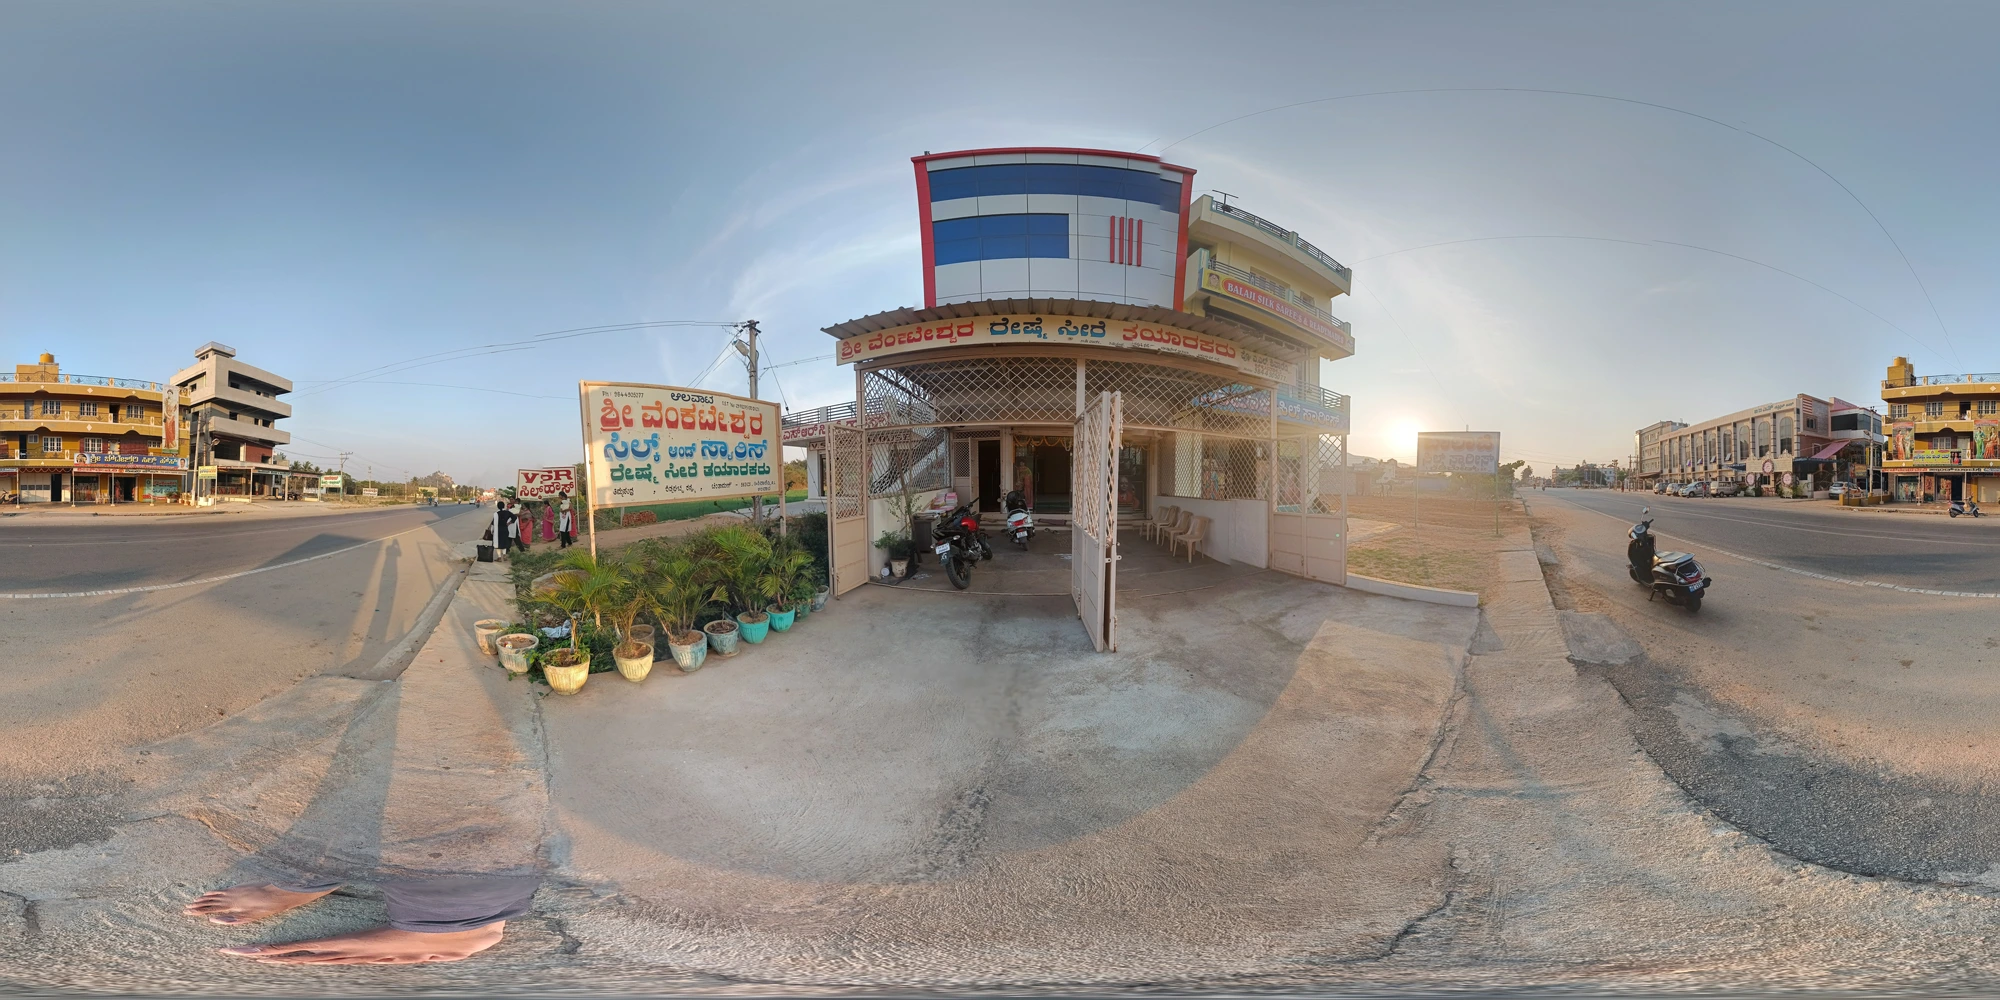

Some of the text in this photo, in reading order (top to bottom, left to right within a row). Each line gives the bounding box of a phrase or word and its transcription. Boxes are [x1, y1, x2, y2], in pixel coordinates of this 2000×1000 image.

[1226, 283, 1256, 301] BALAJI
[1257, 294, 1275, 310] SILK
[1302, 317, 1309, 327] &
[841, 316, 1236, 360] ಶ್ರೀ ವೆಂಕಟೇಶ್ವರ ರೇಷ್ಮೆ ಸೀರೆ ತಯಾರಕರು
[600, 398, 763, 439] ಶ್ರೀ ವೆಂಕಟೇಶ್ವರ
[604, 432, 661, 464] ಸಿಲ್ಕ್
[610, 462, 771, 484] ರೇಷ್ಮೆ ಸೀರೆ ತಯಾರಕರು
[519, 485, 544, 500] ಸಿಲ್ಕ್
